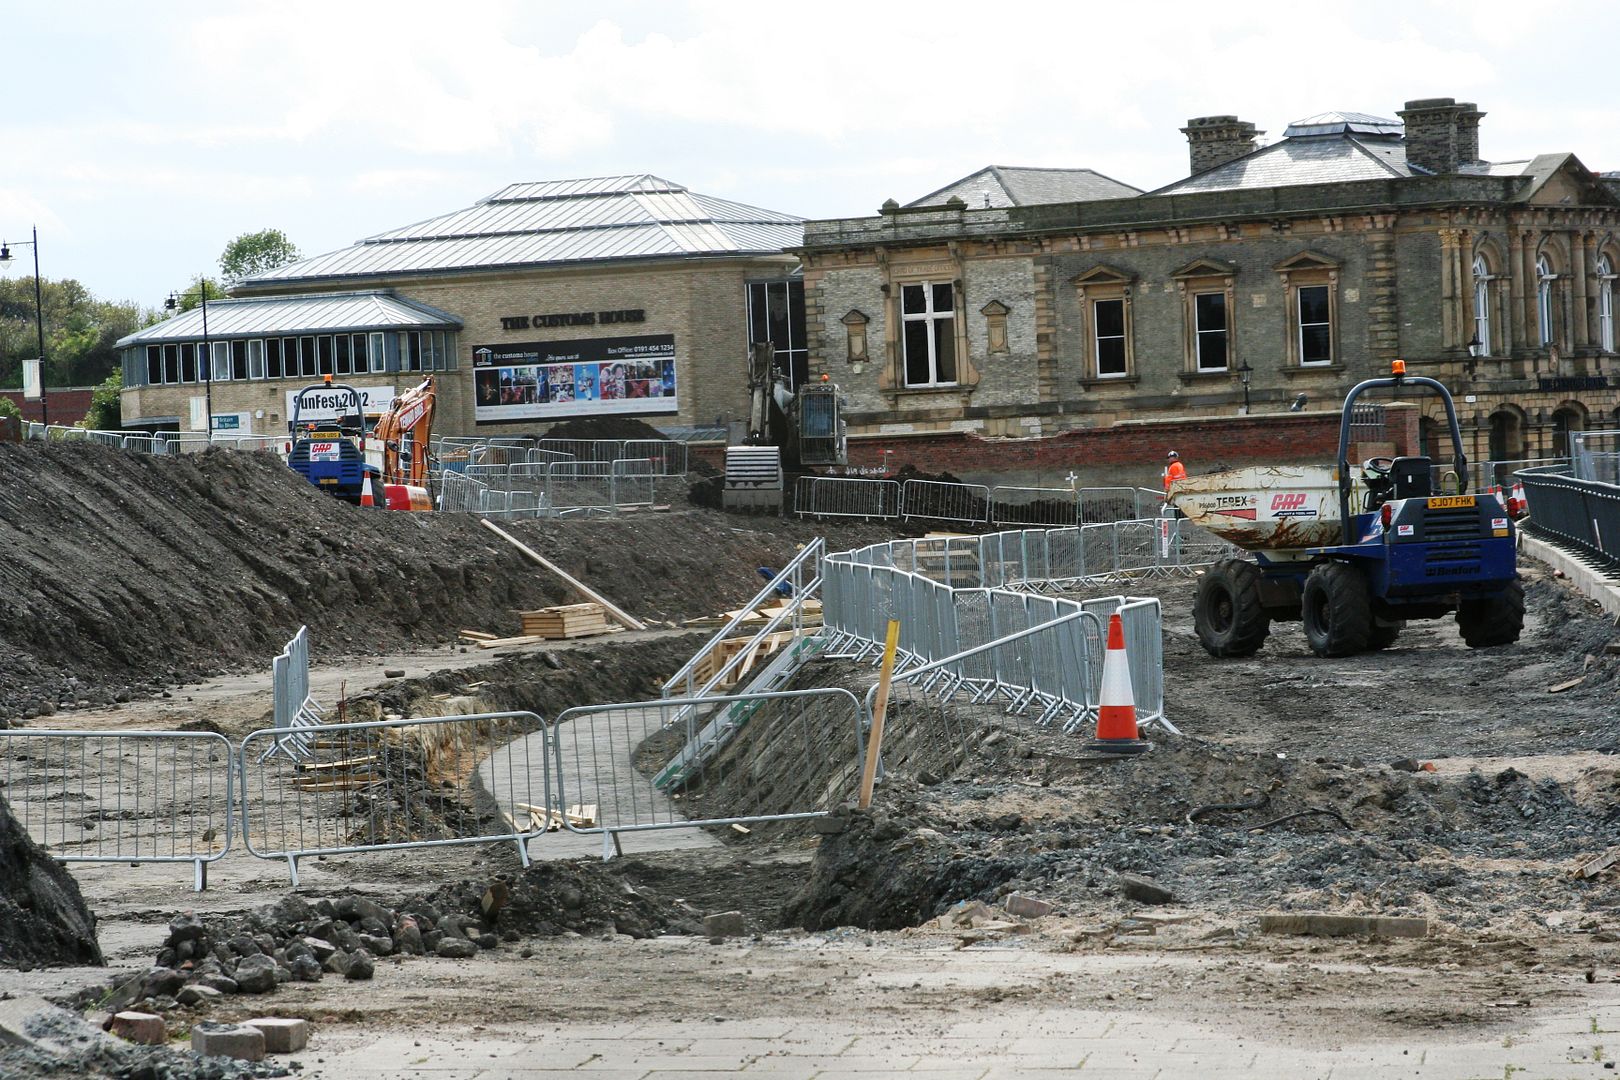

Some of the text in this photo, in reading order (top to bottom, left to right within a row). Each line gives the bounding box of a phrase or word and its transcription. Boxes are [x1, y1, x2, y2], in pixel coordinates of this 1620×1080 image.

[501, 309, 645, 330] THE CUSTOMS HOUSE
[342, 392, 369, 407] 202
[312, 443, 332, 453] GAP
[1216, 496, 1247, 508] TEREX
[1270, 493, 1306, 510] GAP
[1431, 497, 1473, 508] SJ07 FHK
